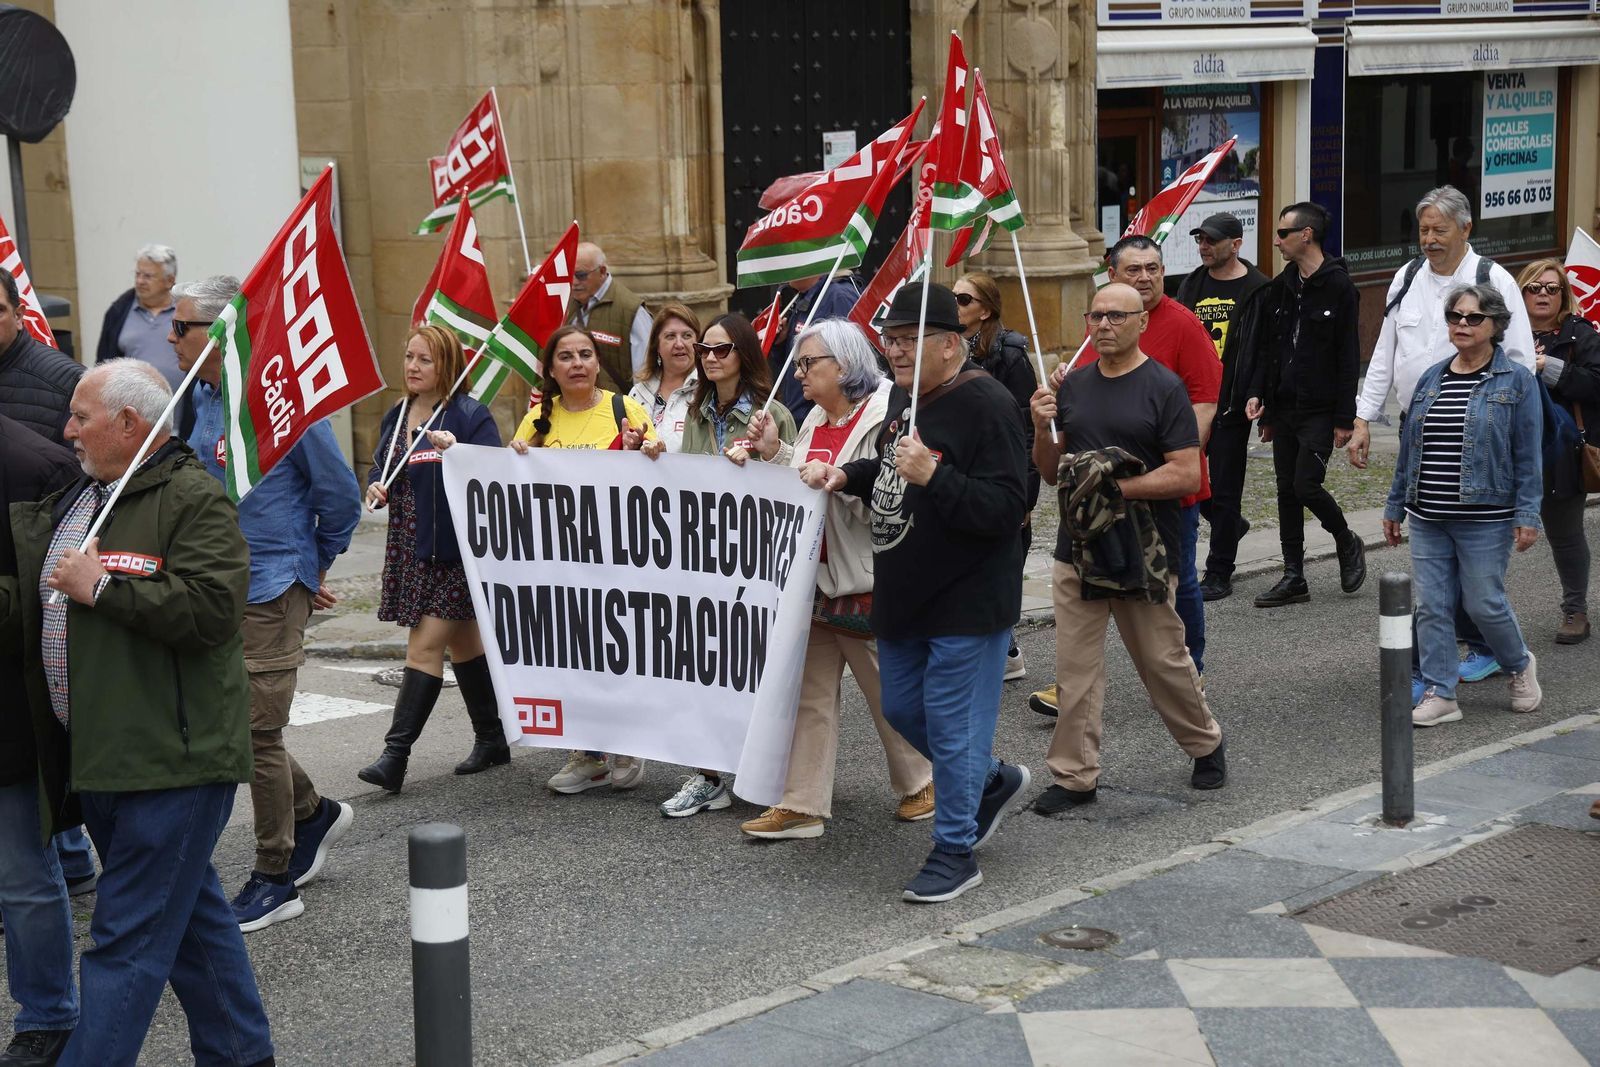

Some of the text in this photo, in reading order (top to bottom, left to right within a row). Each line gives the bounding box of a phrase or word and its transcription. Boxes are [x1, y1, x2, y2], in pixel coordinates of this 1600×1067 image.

[1168, 6, 1246, 19] GRUPO INMOBILIARIO
[1447, 1, 1509, 14] GRUPO INMOBILIARIO
[1473, 43, 1500, 62] aldía
[1193, 54, 1225, 74] aldía
[1487, 72, 1526, 90] VENTA
[1163, 95, 1252, 110] A LA VENTA y ALQUILER
[1487, 90, 1553, 112] Y ALQUILER
[1486, 120, 1529, 137] LOCALES
[1486, 134, 1553, 152] COMERCIALES
[1486, 150, 1538, 171] y OFICINAS
[1485, 186, 1552, 208] 956 66 03 03
[1344, 252, 1360, 262] FICIO
[283, 201, 349, 416] CCOO
[261, 355, 296, 448] Cádiz
[466, 478, 603, 565] CONTRA
[609, 485, 672, 570] LOS
[679, 489, 805, 593] RECORTES
[481, 582, 768, 694] DMINISTRACIÓN
